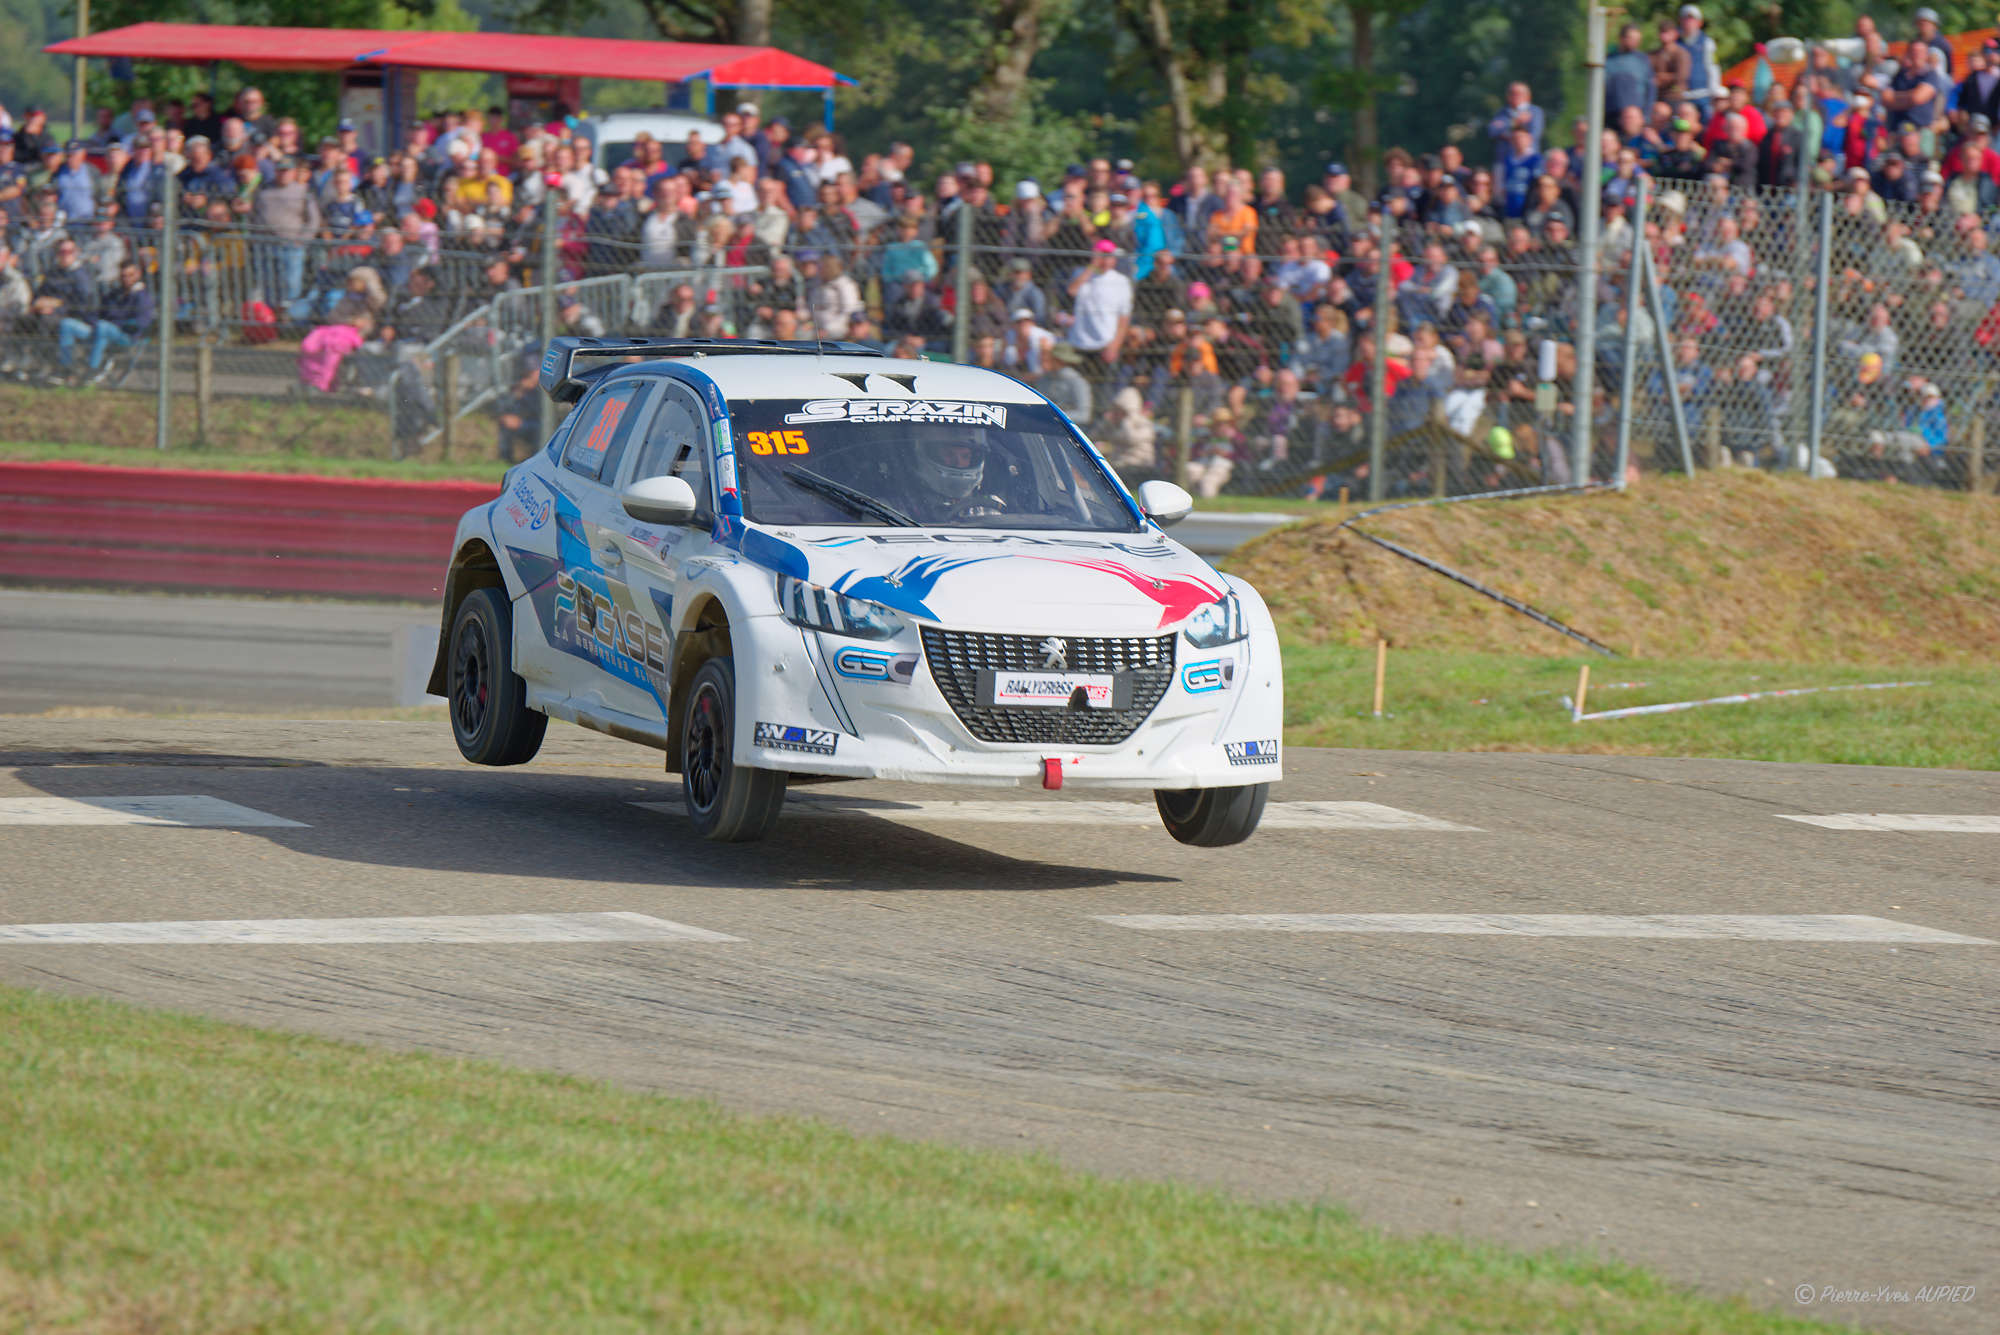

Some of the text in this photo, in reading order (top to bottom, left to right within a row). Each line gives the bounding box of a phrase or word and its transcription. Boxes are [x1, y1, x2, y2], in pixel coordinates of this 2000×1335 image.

[587, 397, 628, 452] 315
[785, 399, 1007, 429] SERAZIN
[850, 415, 991, 425] COMPETITION
[747, 430, 810, 455] 315
[1005, 680, 1073, 695] RALLYCROSS
